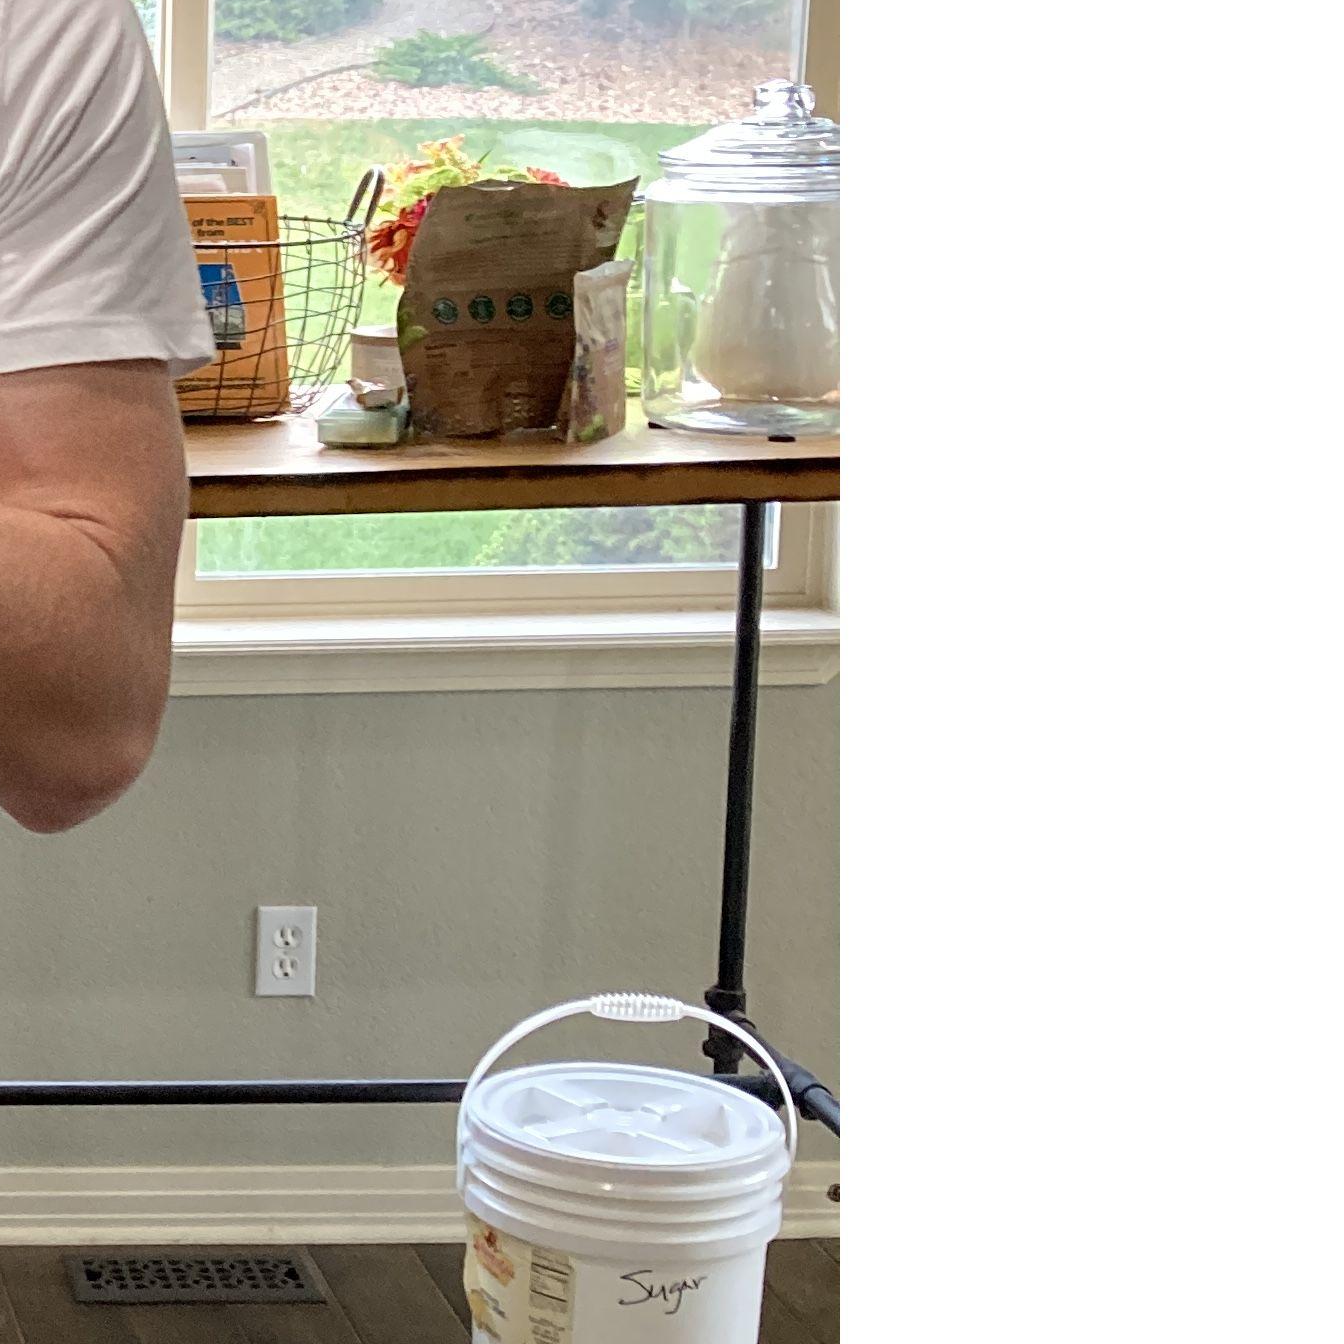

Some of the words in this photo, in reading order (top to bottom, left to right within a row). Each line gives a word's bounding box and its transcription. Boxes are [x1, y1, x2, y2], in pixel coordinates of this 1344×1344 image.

[192, 218, 204, 227] of
[206, 218, 224, 226] the
[227, 217, 255, 226] BEST
[618, 1269, 708, 1315] Sugar
